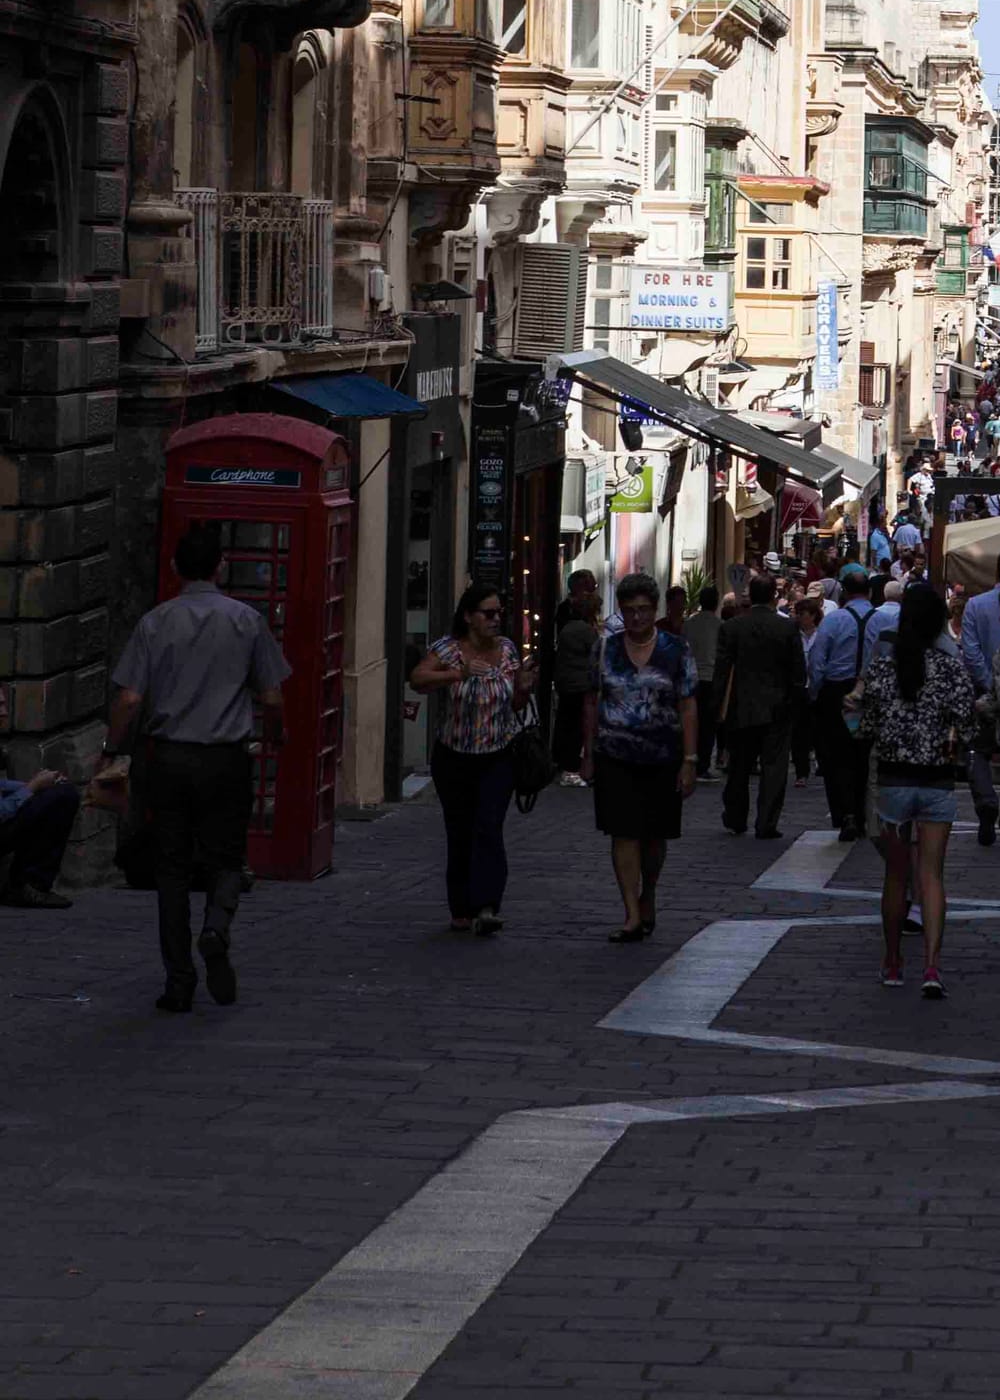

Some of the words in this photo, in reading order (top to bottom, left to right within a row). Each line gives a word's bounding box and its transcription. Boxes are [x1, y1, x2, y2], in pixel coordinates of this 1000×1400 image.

[644, 273, 671, 285] FOR
[682, 274, 714, 287] HRE
[638, 293, 699, 307] MORNING
[708, 298, 718, 308] &
[630, 314, 681, 328] DINNER
[685, 316, 724, 329] SUITS
[817, 283, 831, 376] ENGRAVERS
[210, 467, 277, 481] Cardphone
